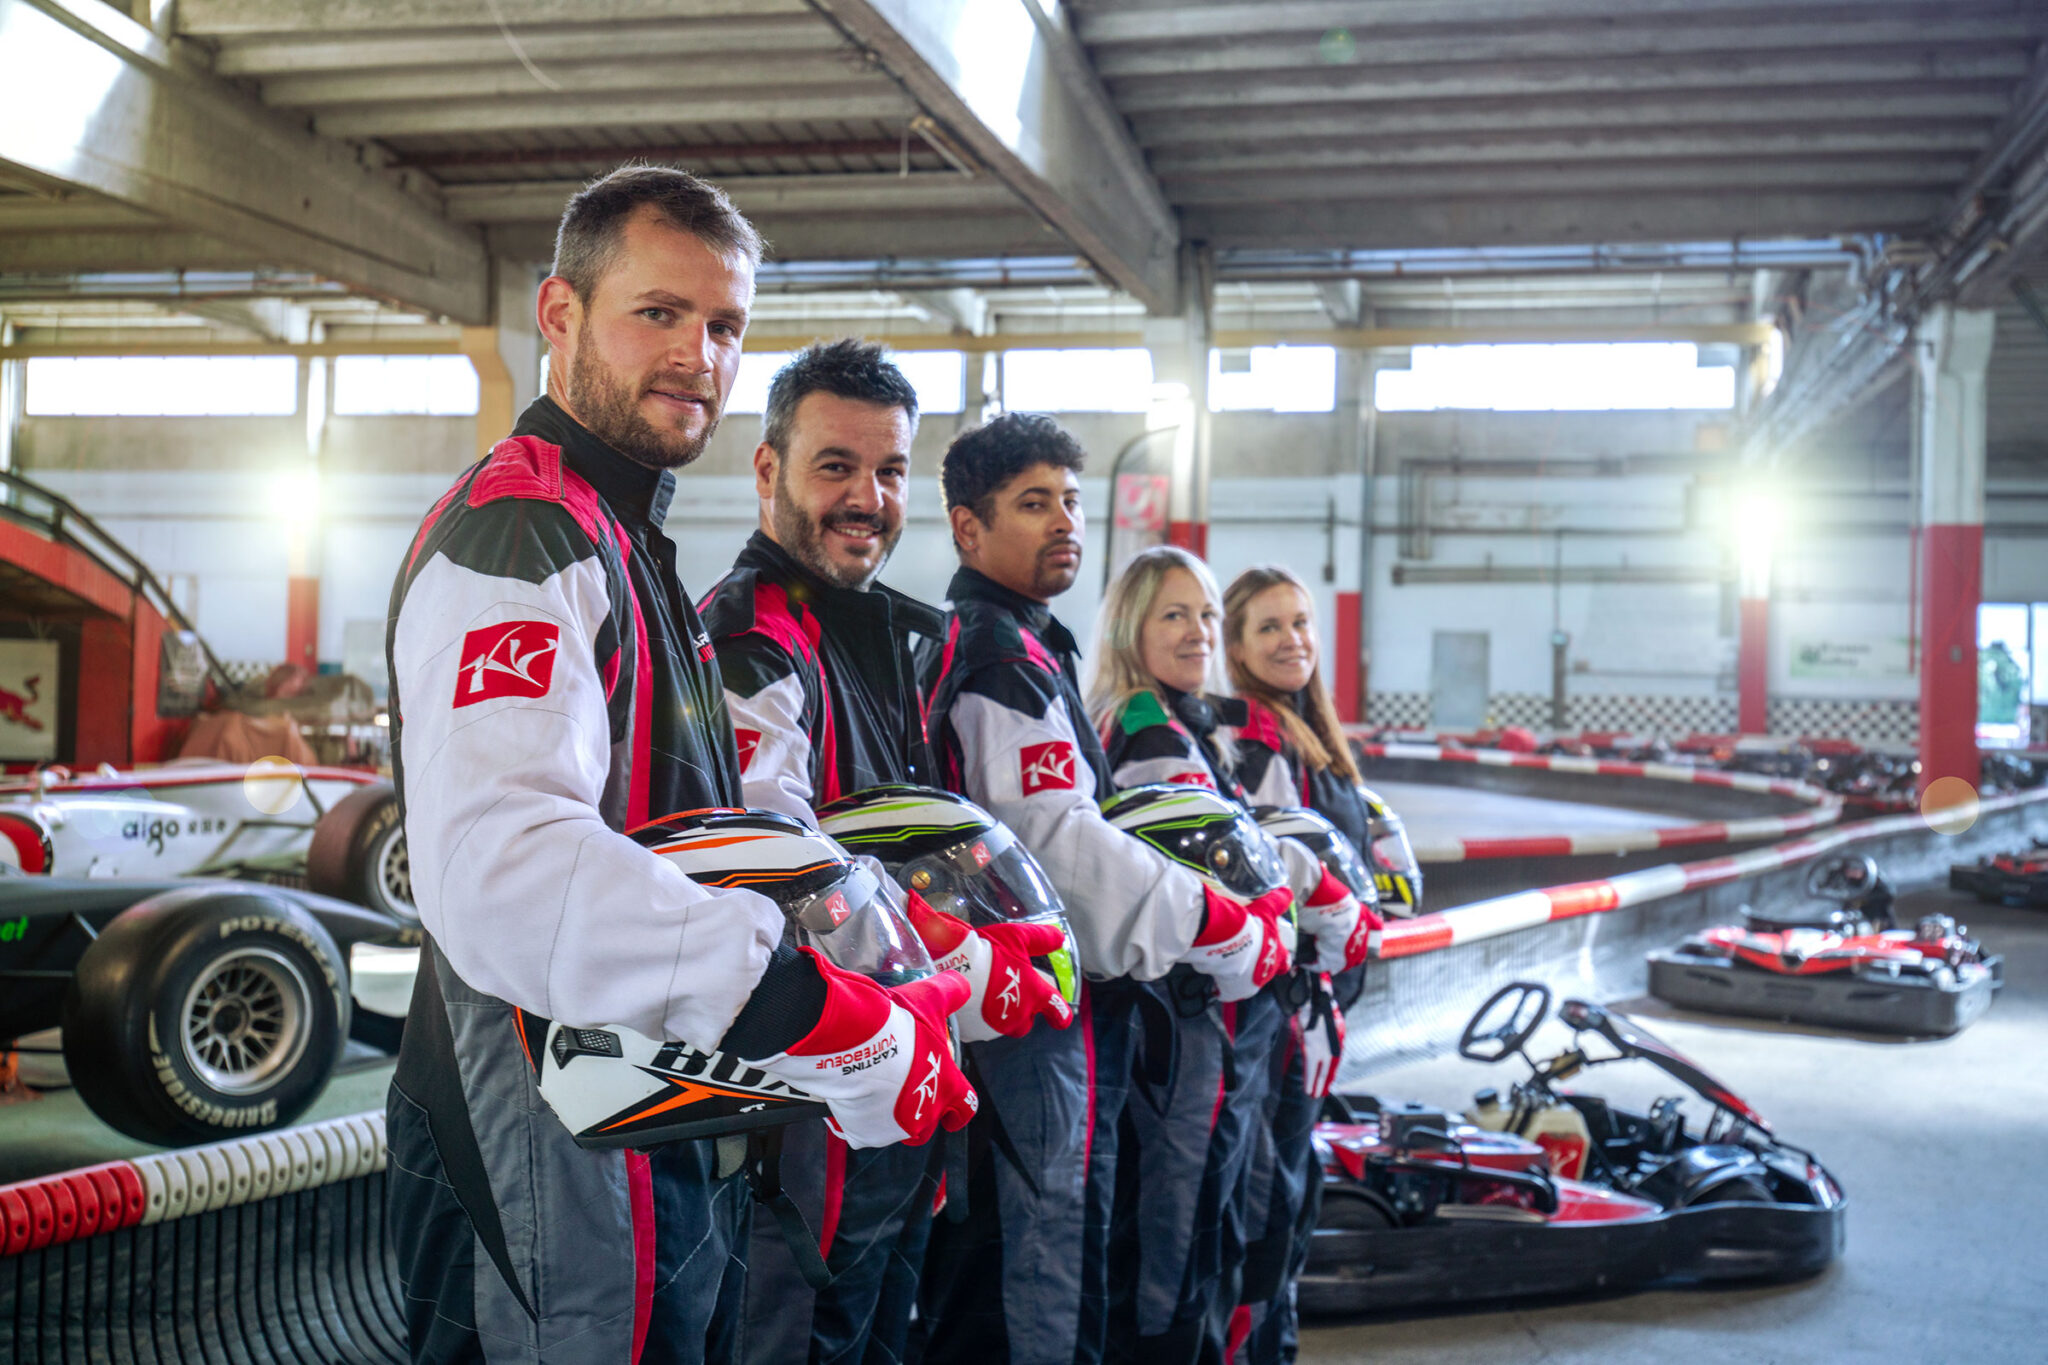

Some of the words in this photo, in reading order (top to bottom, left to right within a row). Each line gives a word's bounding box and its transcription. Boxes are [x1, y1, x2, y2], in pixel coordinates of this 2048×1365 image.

[122, 813, 180, 857] aigo
[219, 915, 337, 988] POTENZA
[815, 1033, 897, 1070] VUITEBOEUF
[842, 1044, 899, 1076] KARTING
